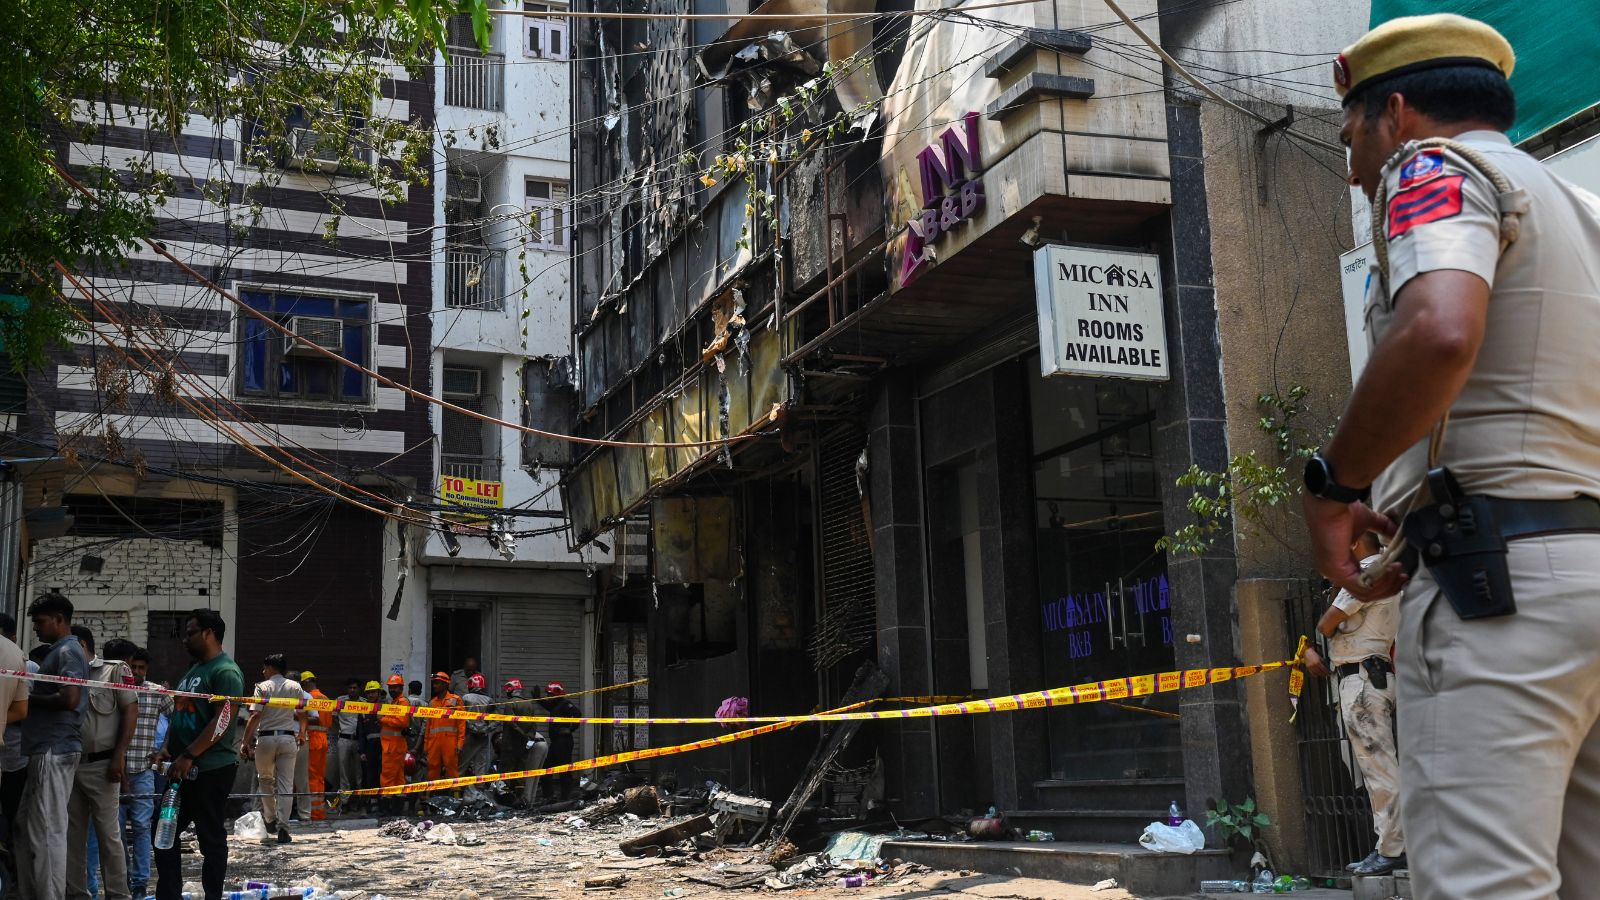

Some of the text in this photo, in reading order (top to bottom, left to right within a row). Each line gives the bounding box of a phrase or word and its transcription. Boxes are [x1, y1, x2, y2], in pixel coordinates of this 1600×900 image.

[922, 178, 985, 246] B&B
[1087, 292, 1129, 313] INN
[1077, 318, 1144, 342] ROOMS
[1065, 342, 1161, 367] AVAILABLE
[444, 478, 464, 492] TO
[476, 482, 500, 497] LET
[456, 494, 498, 505] Commission
[1068, 630, 1092, 659] B&B
